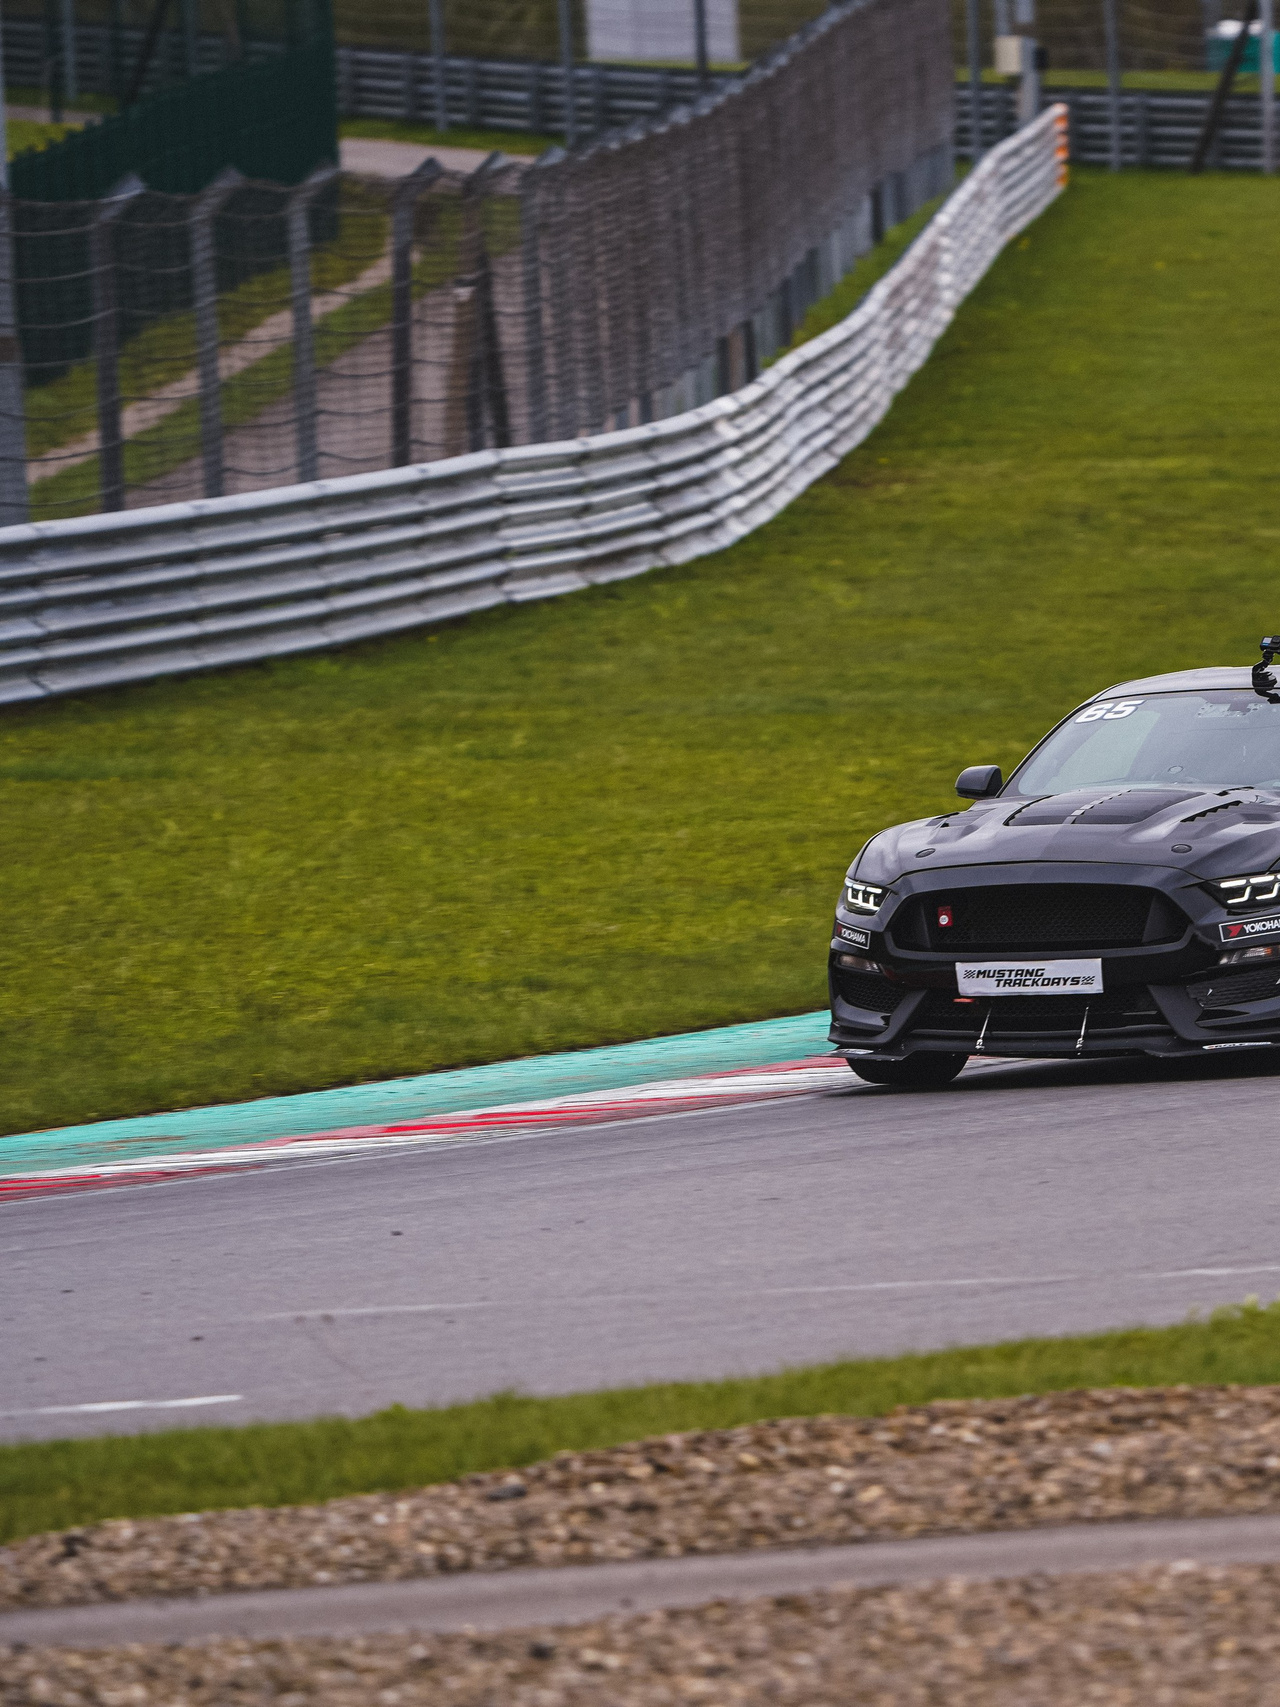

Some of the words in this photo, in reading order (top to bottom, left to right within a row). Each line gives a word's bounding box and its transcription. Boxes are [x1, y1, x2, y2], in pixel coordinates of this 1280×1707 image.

[1075, 699, 1146, 723] 65
[976, 968, 1045, 979] MUSTANG
[994, 976, 1081, 988] TRACKDAYS
